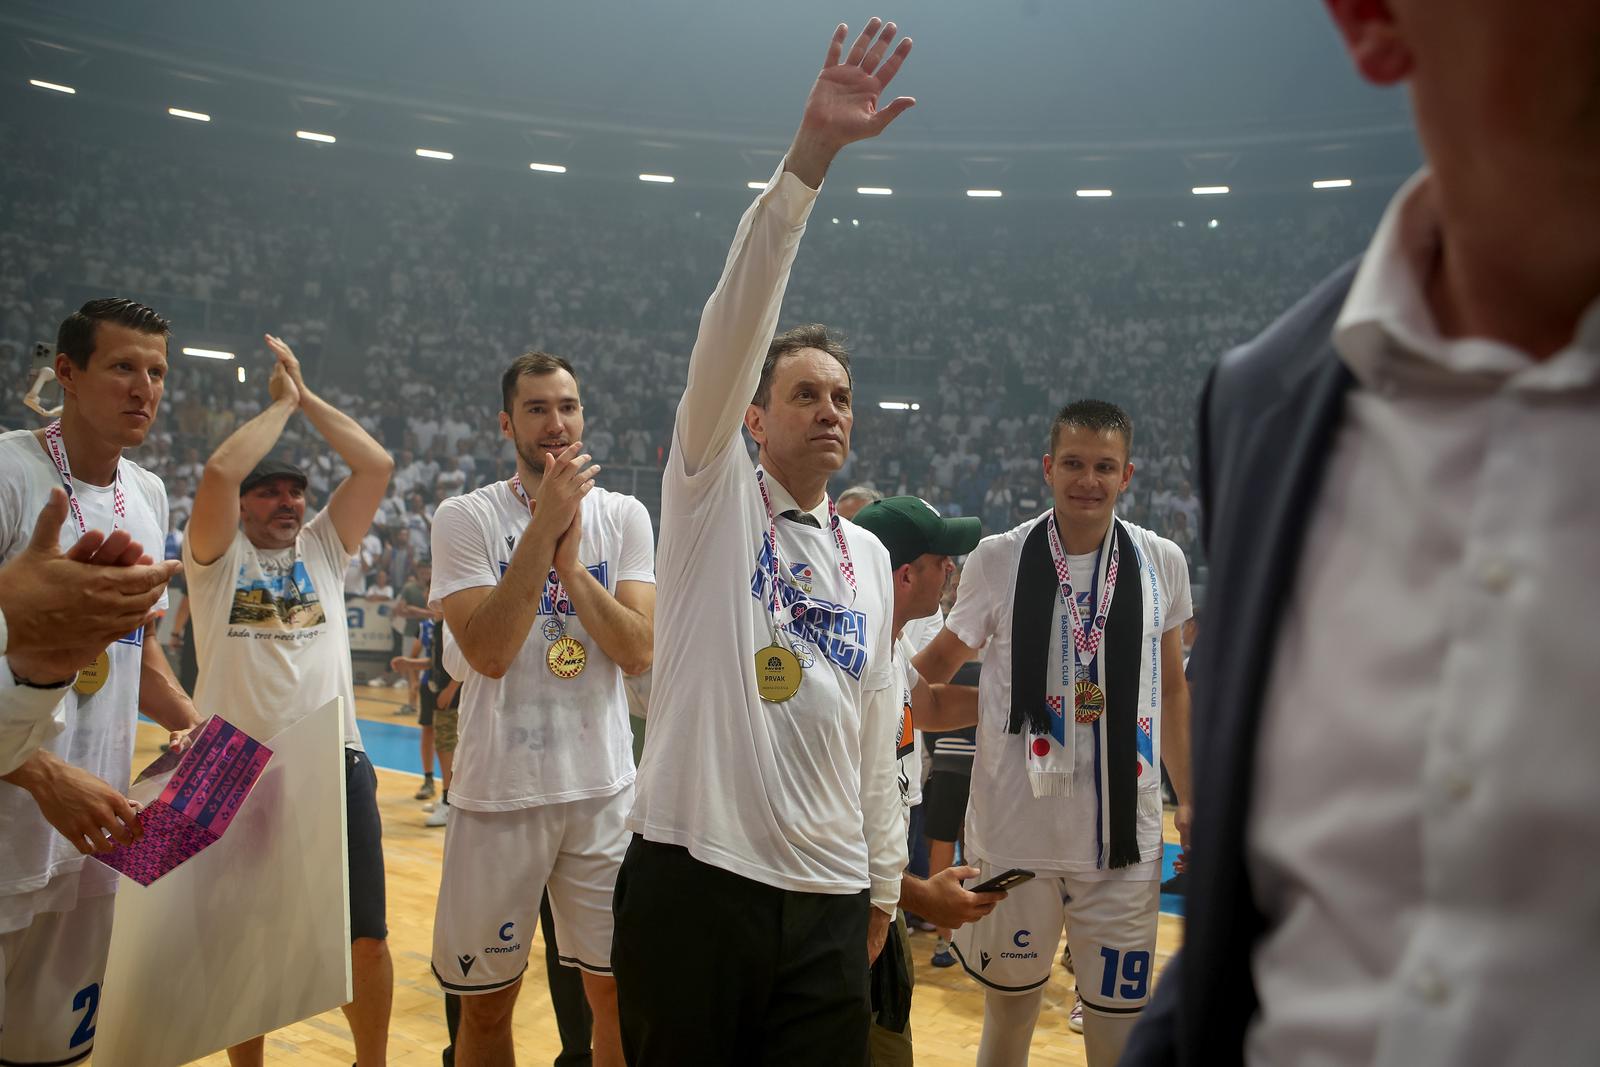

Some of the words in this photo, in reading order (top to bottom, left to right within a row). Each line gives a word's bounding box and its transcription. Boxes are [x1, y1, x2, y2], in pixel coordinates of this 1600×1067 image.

[836, 528, 850, 560] FAVBET
[1060, 614, 1069, 663] BASKETBALL
[484, 943, 521, 954] cromaris
[1000, 950, 1038, 959] cromaris
[1101, 946, 1150, 1000] 19
